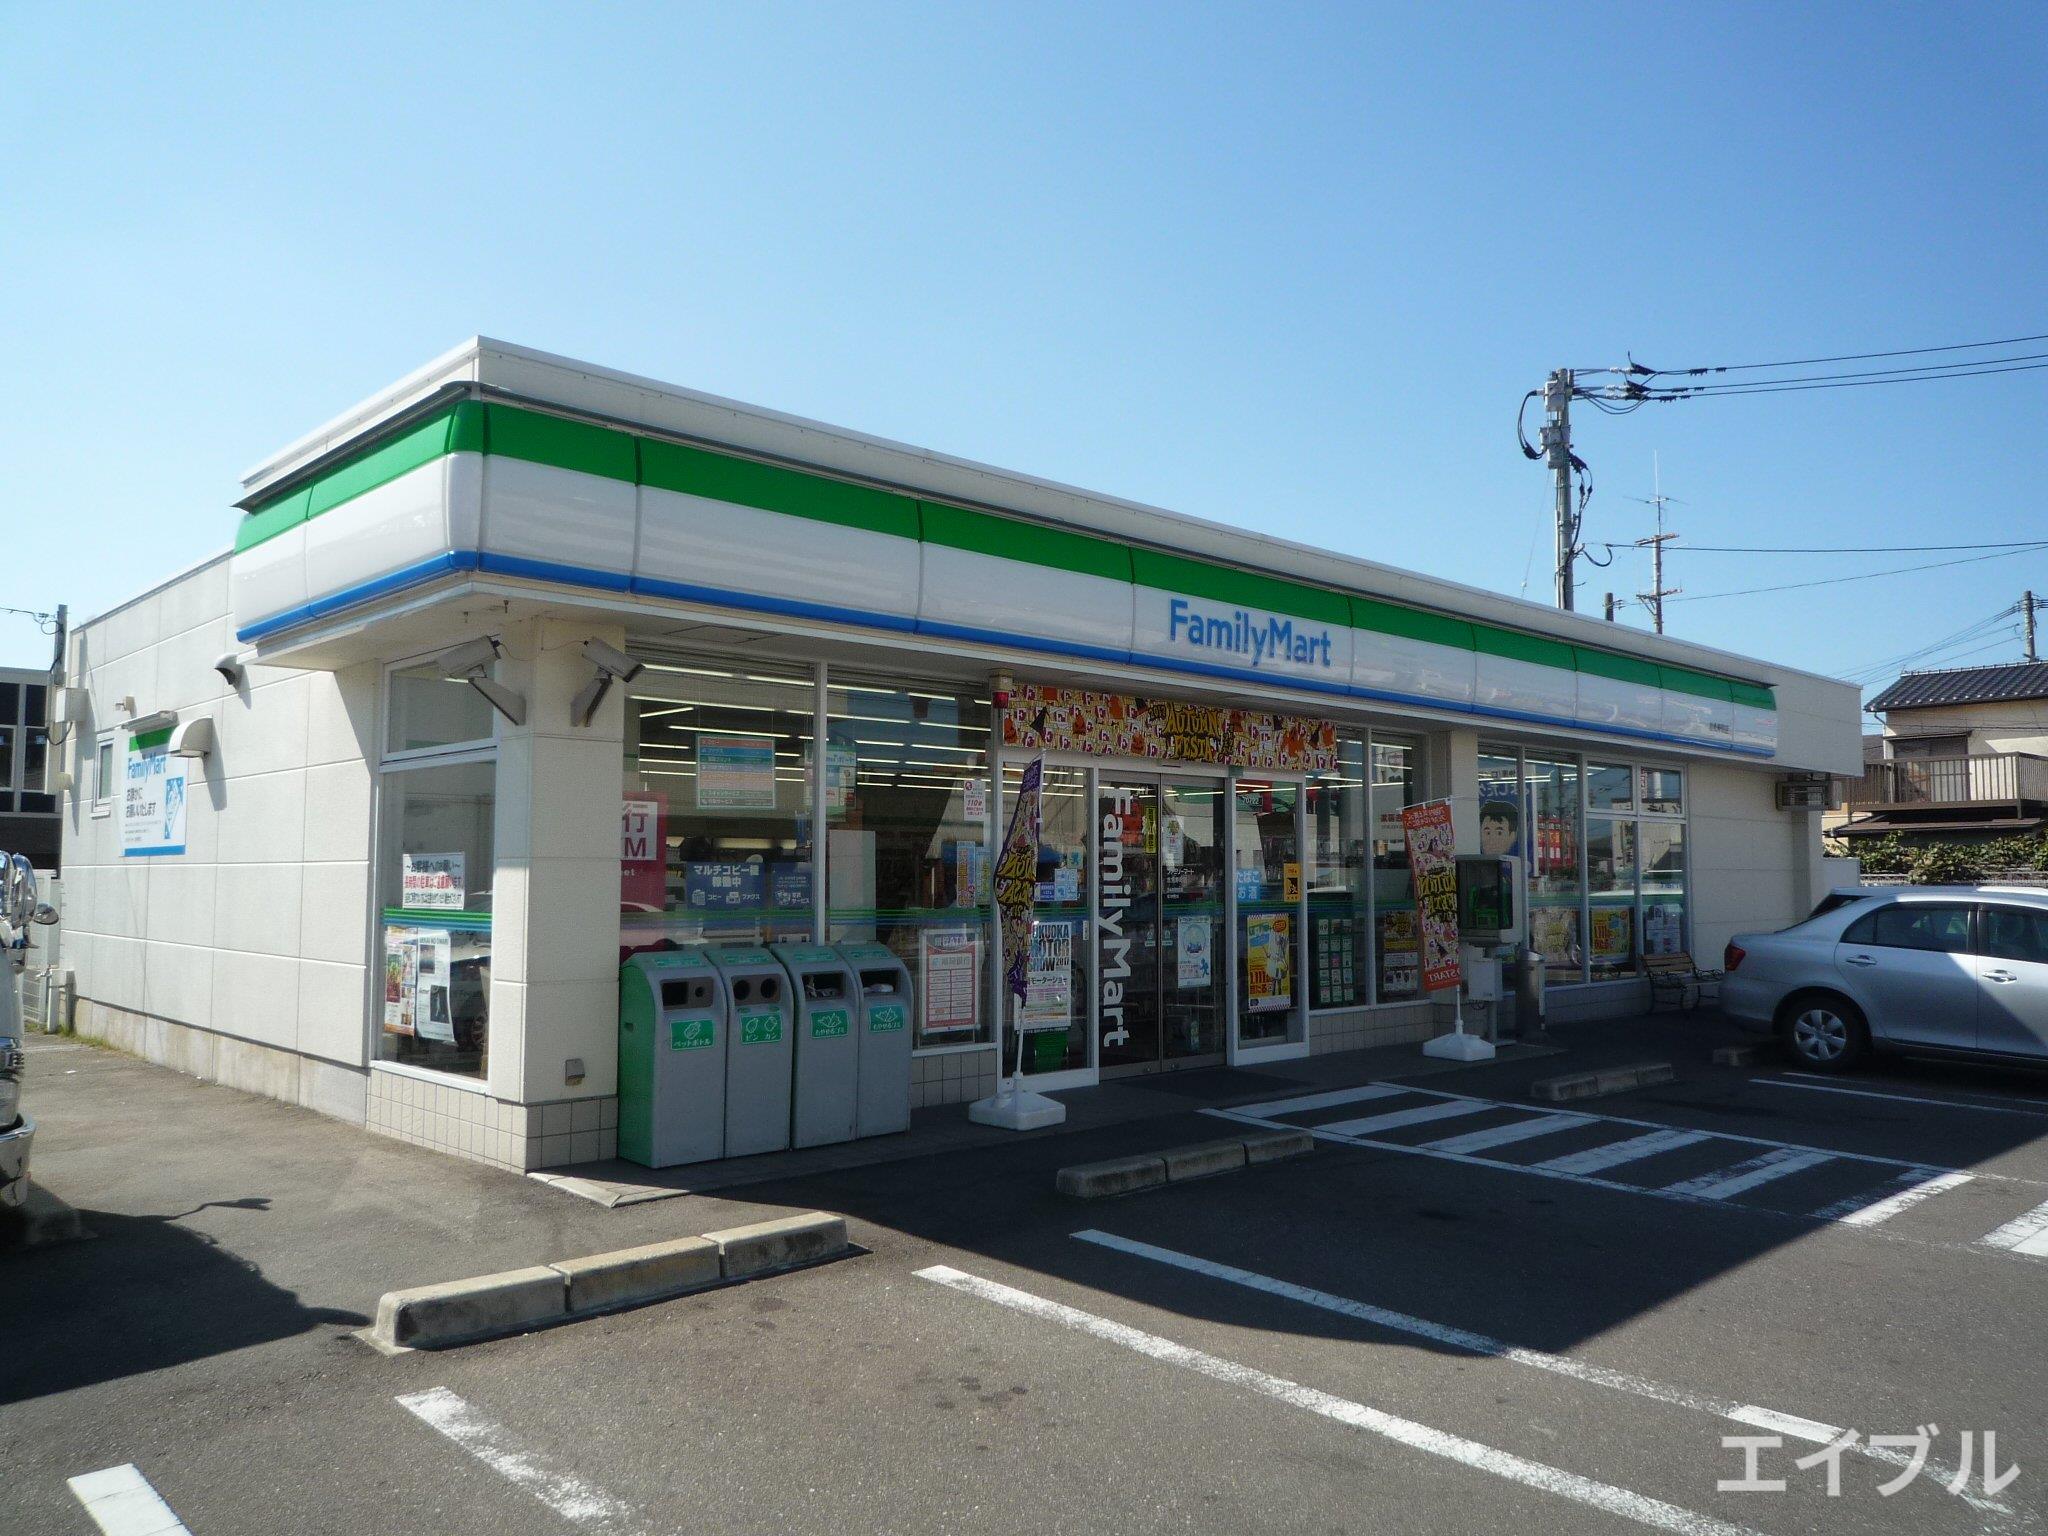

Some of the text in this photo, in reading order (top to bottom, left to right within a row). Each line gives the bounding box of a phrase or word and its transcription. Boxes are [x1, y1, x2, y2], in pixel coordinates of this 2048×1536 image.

[1170, 599, 1332, 668] FamilyMart
[1163, 702, 1221, 737] AUTUMN
[1172, 735, 1216, 762] FESTA
[128, 752, 166, 783] FamilyMart
[694, 865, 760, 877] マルチコピー機
[1237, 870, 1259, 883] たばこ
[1238, 886, 1258, 899] お酒
[1099, 788, 1132, 1049] FamilyMart
[1033, 924, 1069, 939] UKUOKA
[1031, 939, 1069, 957] MOTOR
[673, 1039, 711, 1048] ペットボトル
